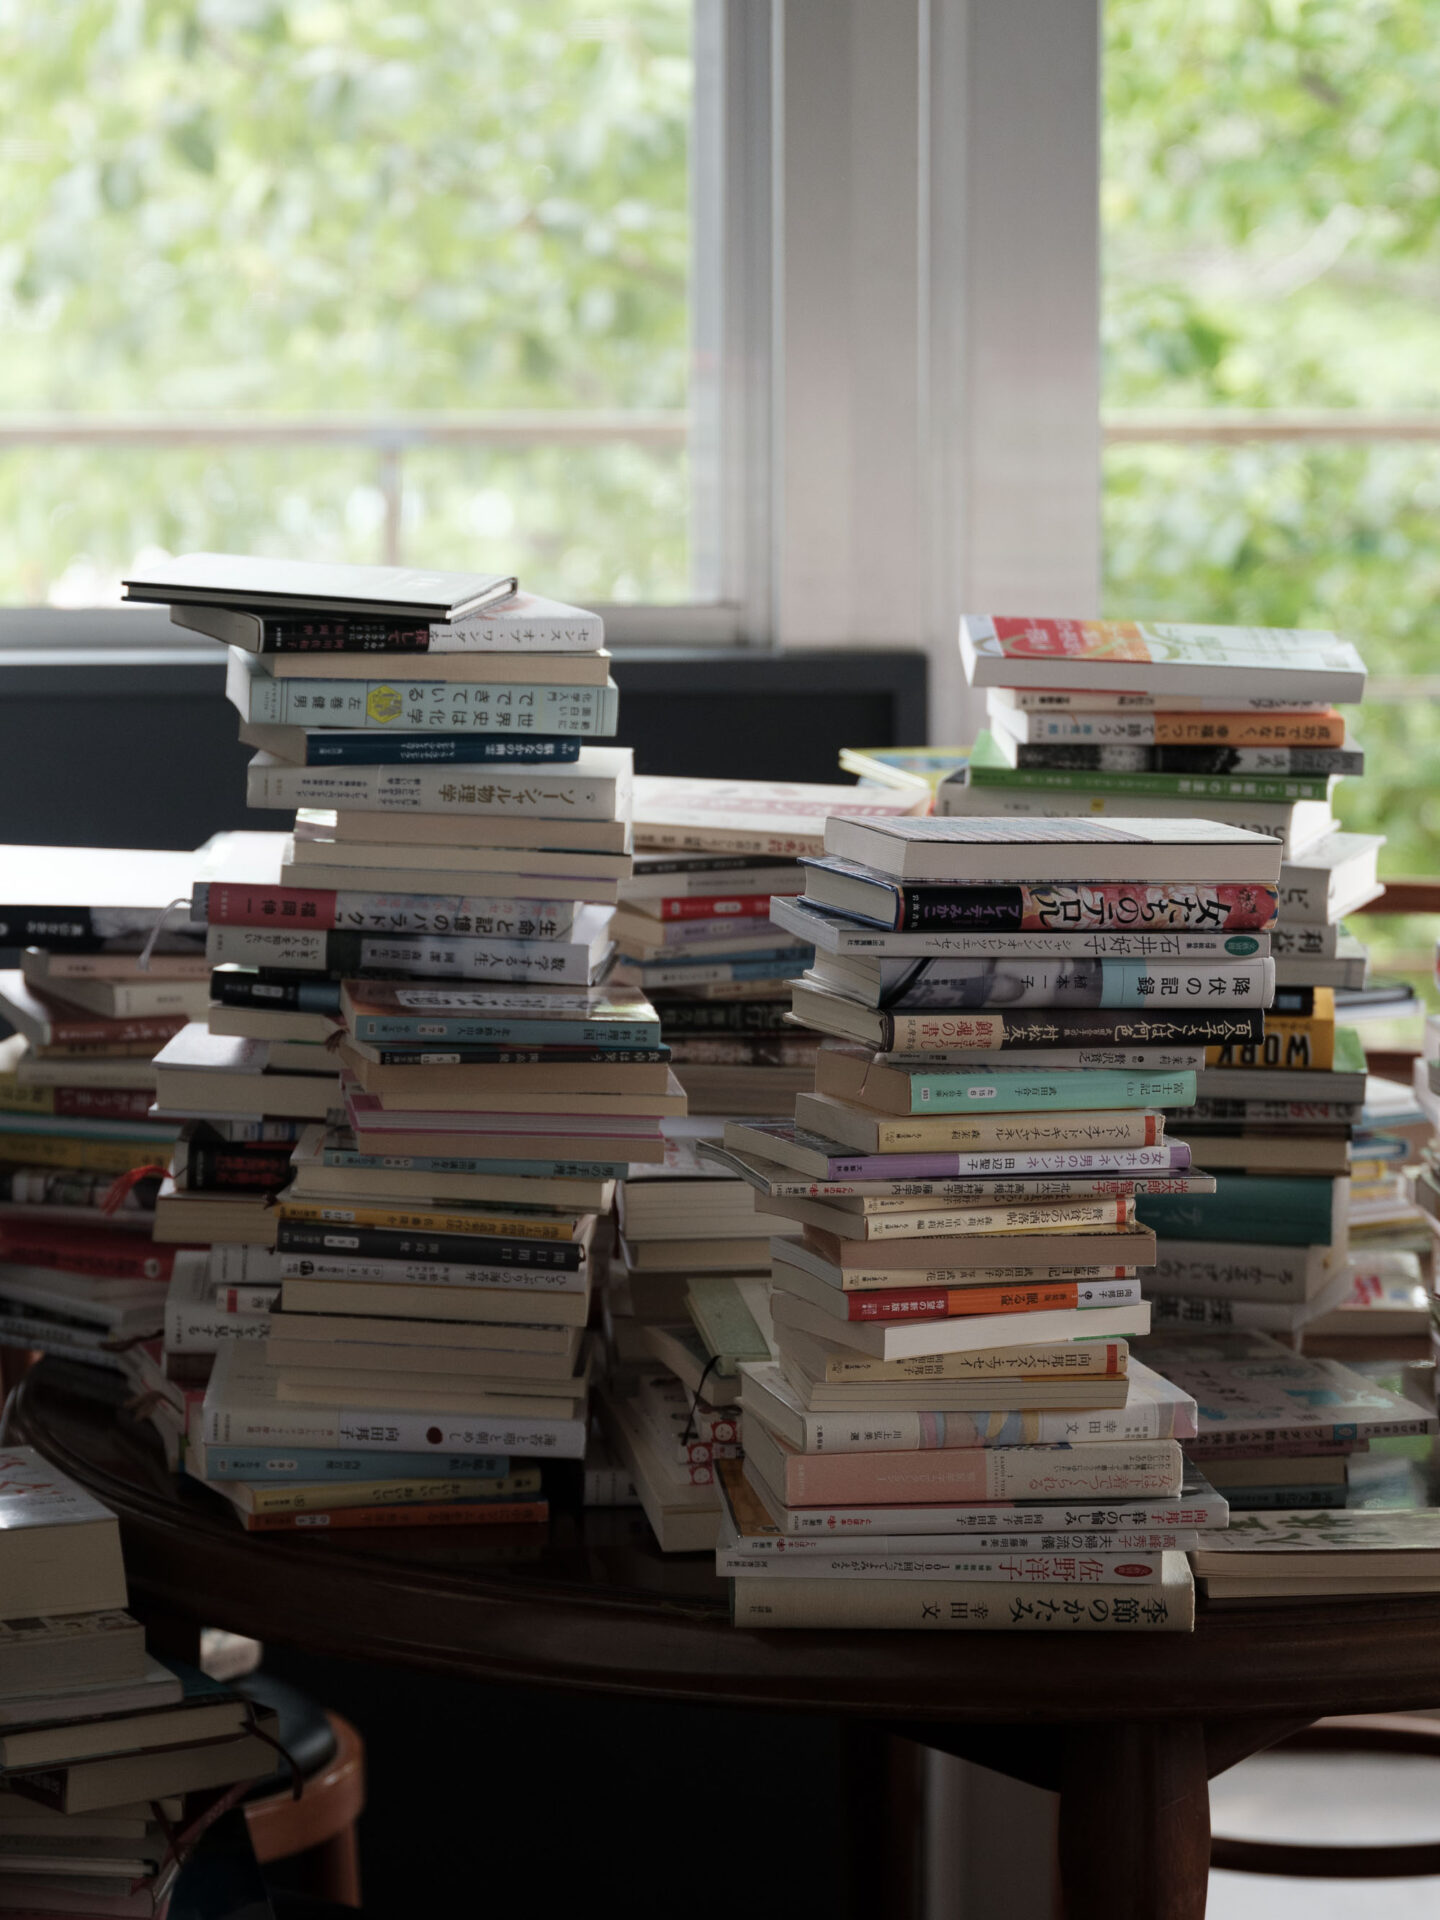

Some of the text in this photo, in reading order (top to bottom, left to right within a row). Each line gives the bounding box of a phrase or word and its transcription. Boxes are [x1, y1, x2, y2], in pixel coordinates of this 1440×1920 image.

[293, 695, 362, 711] 左巻健男
[408, 687, 534, 707] でできている
[547, 691, 592, 704] 化学入門
[408, 708, 533, 728] 世界史は化学
[437, 784, 576, 806] ソーシャル物理学
[247, 897, 317, 918] 福岡伸一
[911, 893, 920, 928] 岩波書店
[924, 904, 1020, 919] ブレイディみかこ
[1037, 896, 1232, 928] 女たちのテロル
[245, 933, 320, 946] この人を知りたい
[1084, 935, 1181, 956] 石井好子
[474, 952, 566, 972] 数学する人生
[1020, 974, 1088, 990] 植本一子
[1137, 976, 1251, 996] 降伏の記録
[583, 1028, 632, 1041] 料理王国
[907, 1019, 917, 1050] 筑摩書房
[921, 1021, 993, 1037] 鎮魂の書
[1114, 1019, 1253, 1041] 百合子さんは何色
[921, 1037, 993, 1049] 書き下ろし
[1218, 1035, 1310, 1067] WORK
[1079, 1051, 1128, 1066] 贅沢貧乏
[1159, 1055, 1198, 1066] 森茉莉
[1014, 1086, 1058, 1097] 武田百合子
[1140, 1081, 1185, 1096] 富士日記
[952, 1128, 981, 1140] 森茉莉
[994, 1124, 1131, 1142] ベスト・オブ・ドッキリチャンネル
[968, 1158, 1016, 1171] 田辺聖子
[1026, 1152, 1164, 1169] 女のホンネ 男のホンネ
[552, 1163, 615, 1177] 男の手料理
[890, 1183, 933, 1196] 藤島宇内
[943, 1183, 984, 1196] 津村節子
[1036, 1183, 1070, 1194] 北川太一
[1091, 1180, 1188, 1195] 光太郎と智恵子
[1007, 1206, 1104, 1226] 贅沢貧乏のお洒落帖
[502, 1247, 566, 1264] 開口閉口
[464, 1270, 567, 1287] ひさしぶりの海苔弁
[926, 1270, 956, 1282] 武田花
[984, 1267, 1034, 1278] 武田百合子
[1048, 1265, 1100, 1278] 遊覧日記
[1001, 1292, 1039, 1306] 眠る盃
[1099, 1288, 1133, 1299] 向田邦子
[904, 1364, 944, 1376] 向田邦子
[960, 1353, 1092, 1371] 向田邦子ベスト・エッセイ
[340, 1426, 400, 1442] 向田邦子
[864, 1430, 902, 1440] 川上弘美
[1064, 1420, 1117, 1434] 幸田 文
[449, 1431, 557, 1448] 海苔と卵と朝めし
[420, 1483, 460, 1497] おいしい
[1029, 1474, 1173, 1493] 女は下着でつくられる
[956, 1514, 1043, 1526] 向田邦子 向田和子
[1065, 1509, 1208, 1526] 向田邦子 暮しの愉しみ
[1041, 1534, 1176, 1550] 高峰秀子 夫婦の流儀
[831, 1560, 950, 1573] 100万回だってよみがえる
[998, 1555, 1104, 1582] 佐野洋子
[921, 1601, 990, 1620] 幸田 文
[1008, 1596, 1169, 1625] 季節のかたみ
